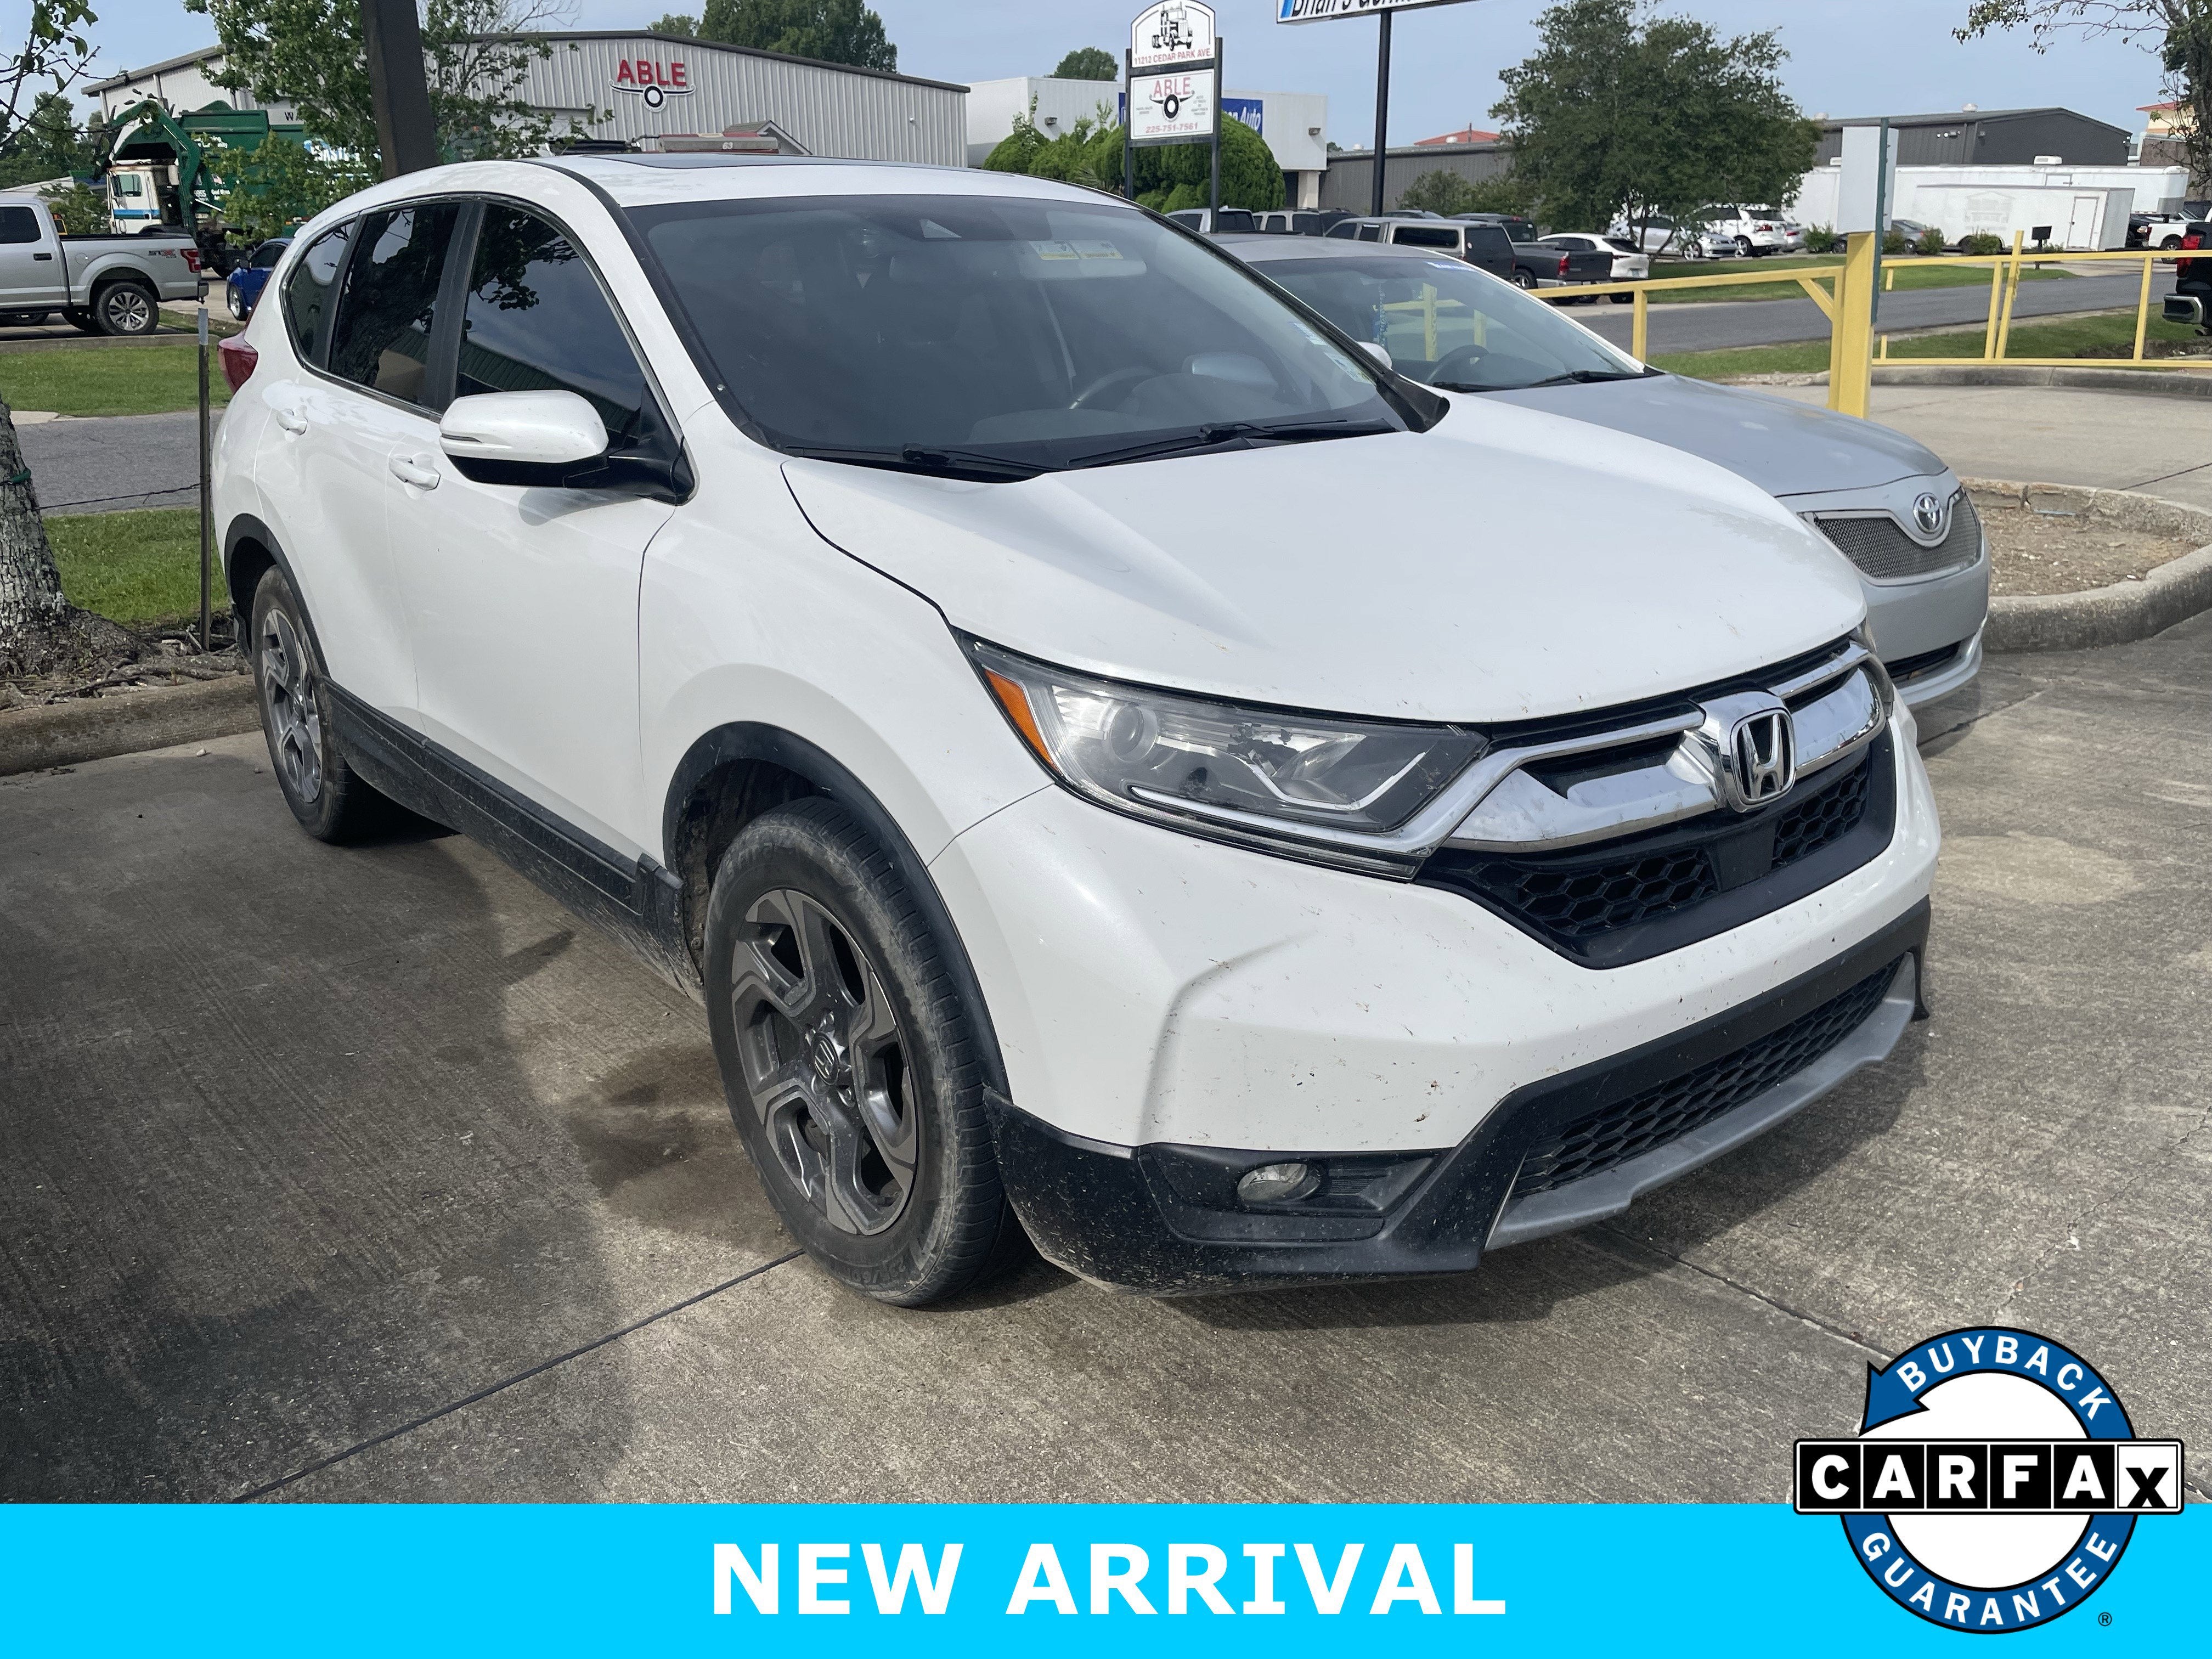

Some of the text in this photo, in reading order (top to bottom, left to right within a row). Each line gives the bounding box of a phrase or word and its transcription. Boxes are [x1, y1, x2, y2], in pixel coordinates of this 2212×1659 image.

[1134, 55, 1152, 65] 11212
[1153, 52, 1176, 63] CEDAR
[1177, 49, 1195, 59] PARK
[617, 59, 687, 86] ABLE
[1153, 77, 1191, 98] ABLE
[1146, 122, 1198, 133] 225-751-7561
[1240, 106, 1261, 131] Auto
